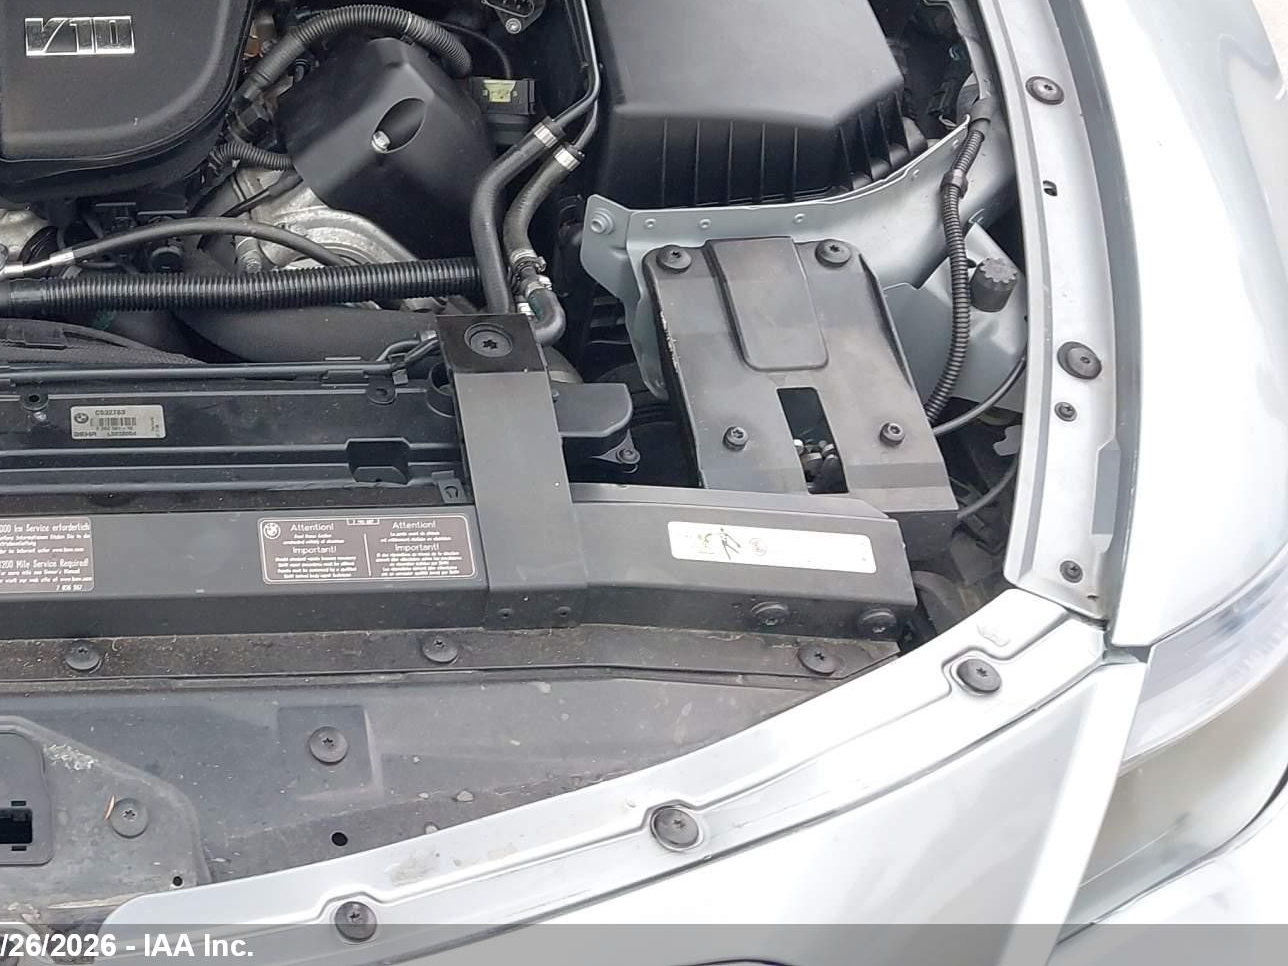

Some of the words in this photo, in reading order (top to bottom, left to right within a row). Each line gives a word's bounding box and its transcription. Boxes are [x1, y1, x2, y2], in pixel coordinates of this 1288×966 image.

[24, 16, 135, 56] V10
[26, 523, 50, 532] Service
[290, 523, 334, 532] Attention!
[392, 520, 436, 529] Attention!
[292, 545, 337, 555] Important!
[394, 543, 440, 552] Important!
[33, 559, 57, 568] Service
